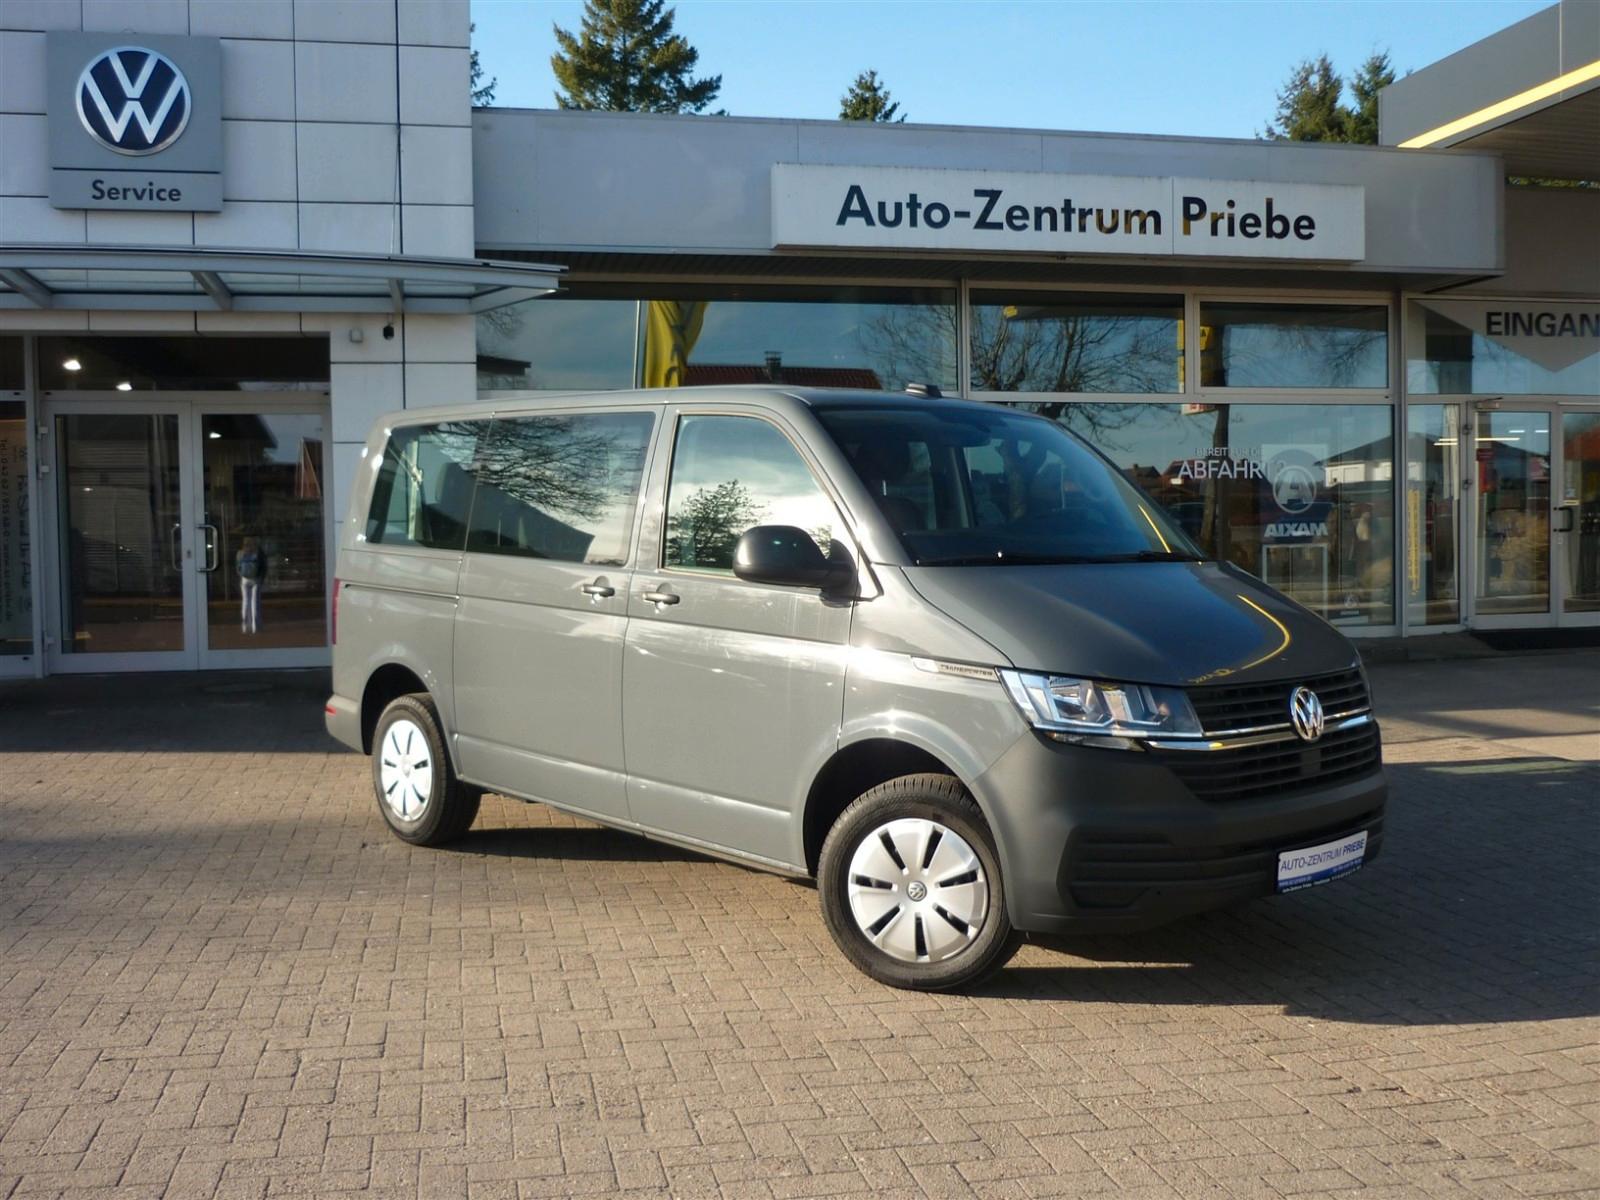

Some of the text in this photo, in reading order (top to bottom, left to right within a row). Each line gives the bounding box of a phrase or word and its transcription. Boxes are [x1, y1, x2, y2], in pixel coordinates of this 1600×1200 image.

[76, 46, 191, 157] VW
[92, 179, 182, 201] Service
[836, 184, 1316, 240] Auto-Zentrum Priebe
[1264, 522, 1328, 537] AIXAM
[1281, 847, 1342, 872] AUTO-ZENTRUM
[1342, 838, 1365, 857] PRIEBE
